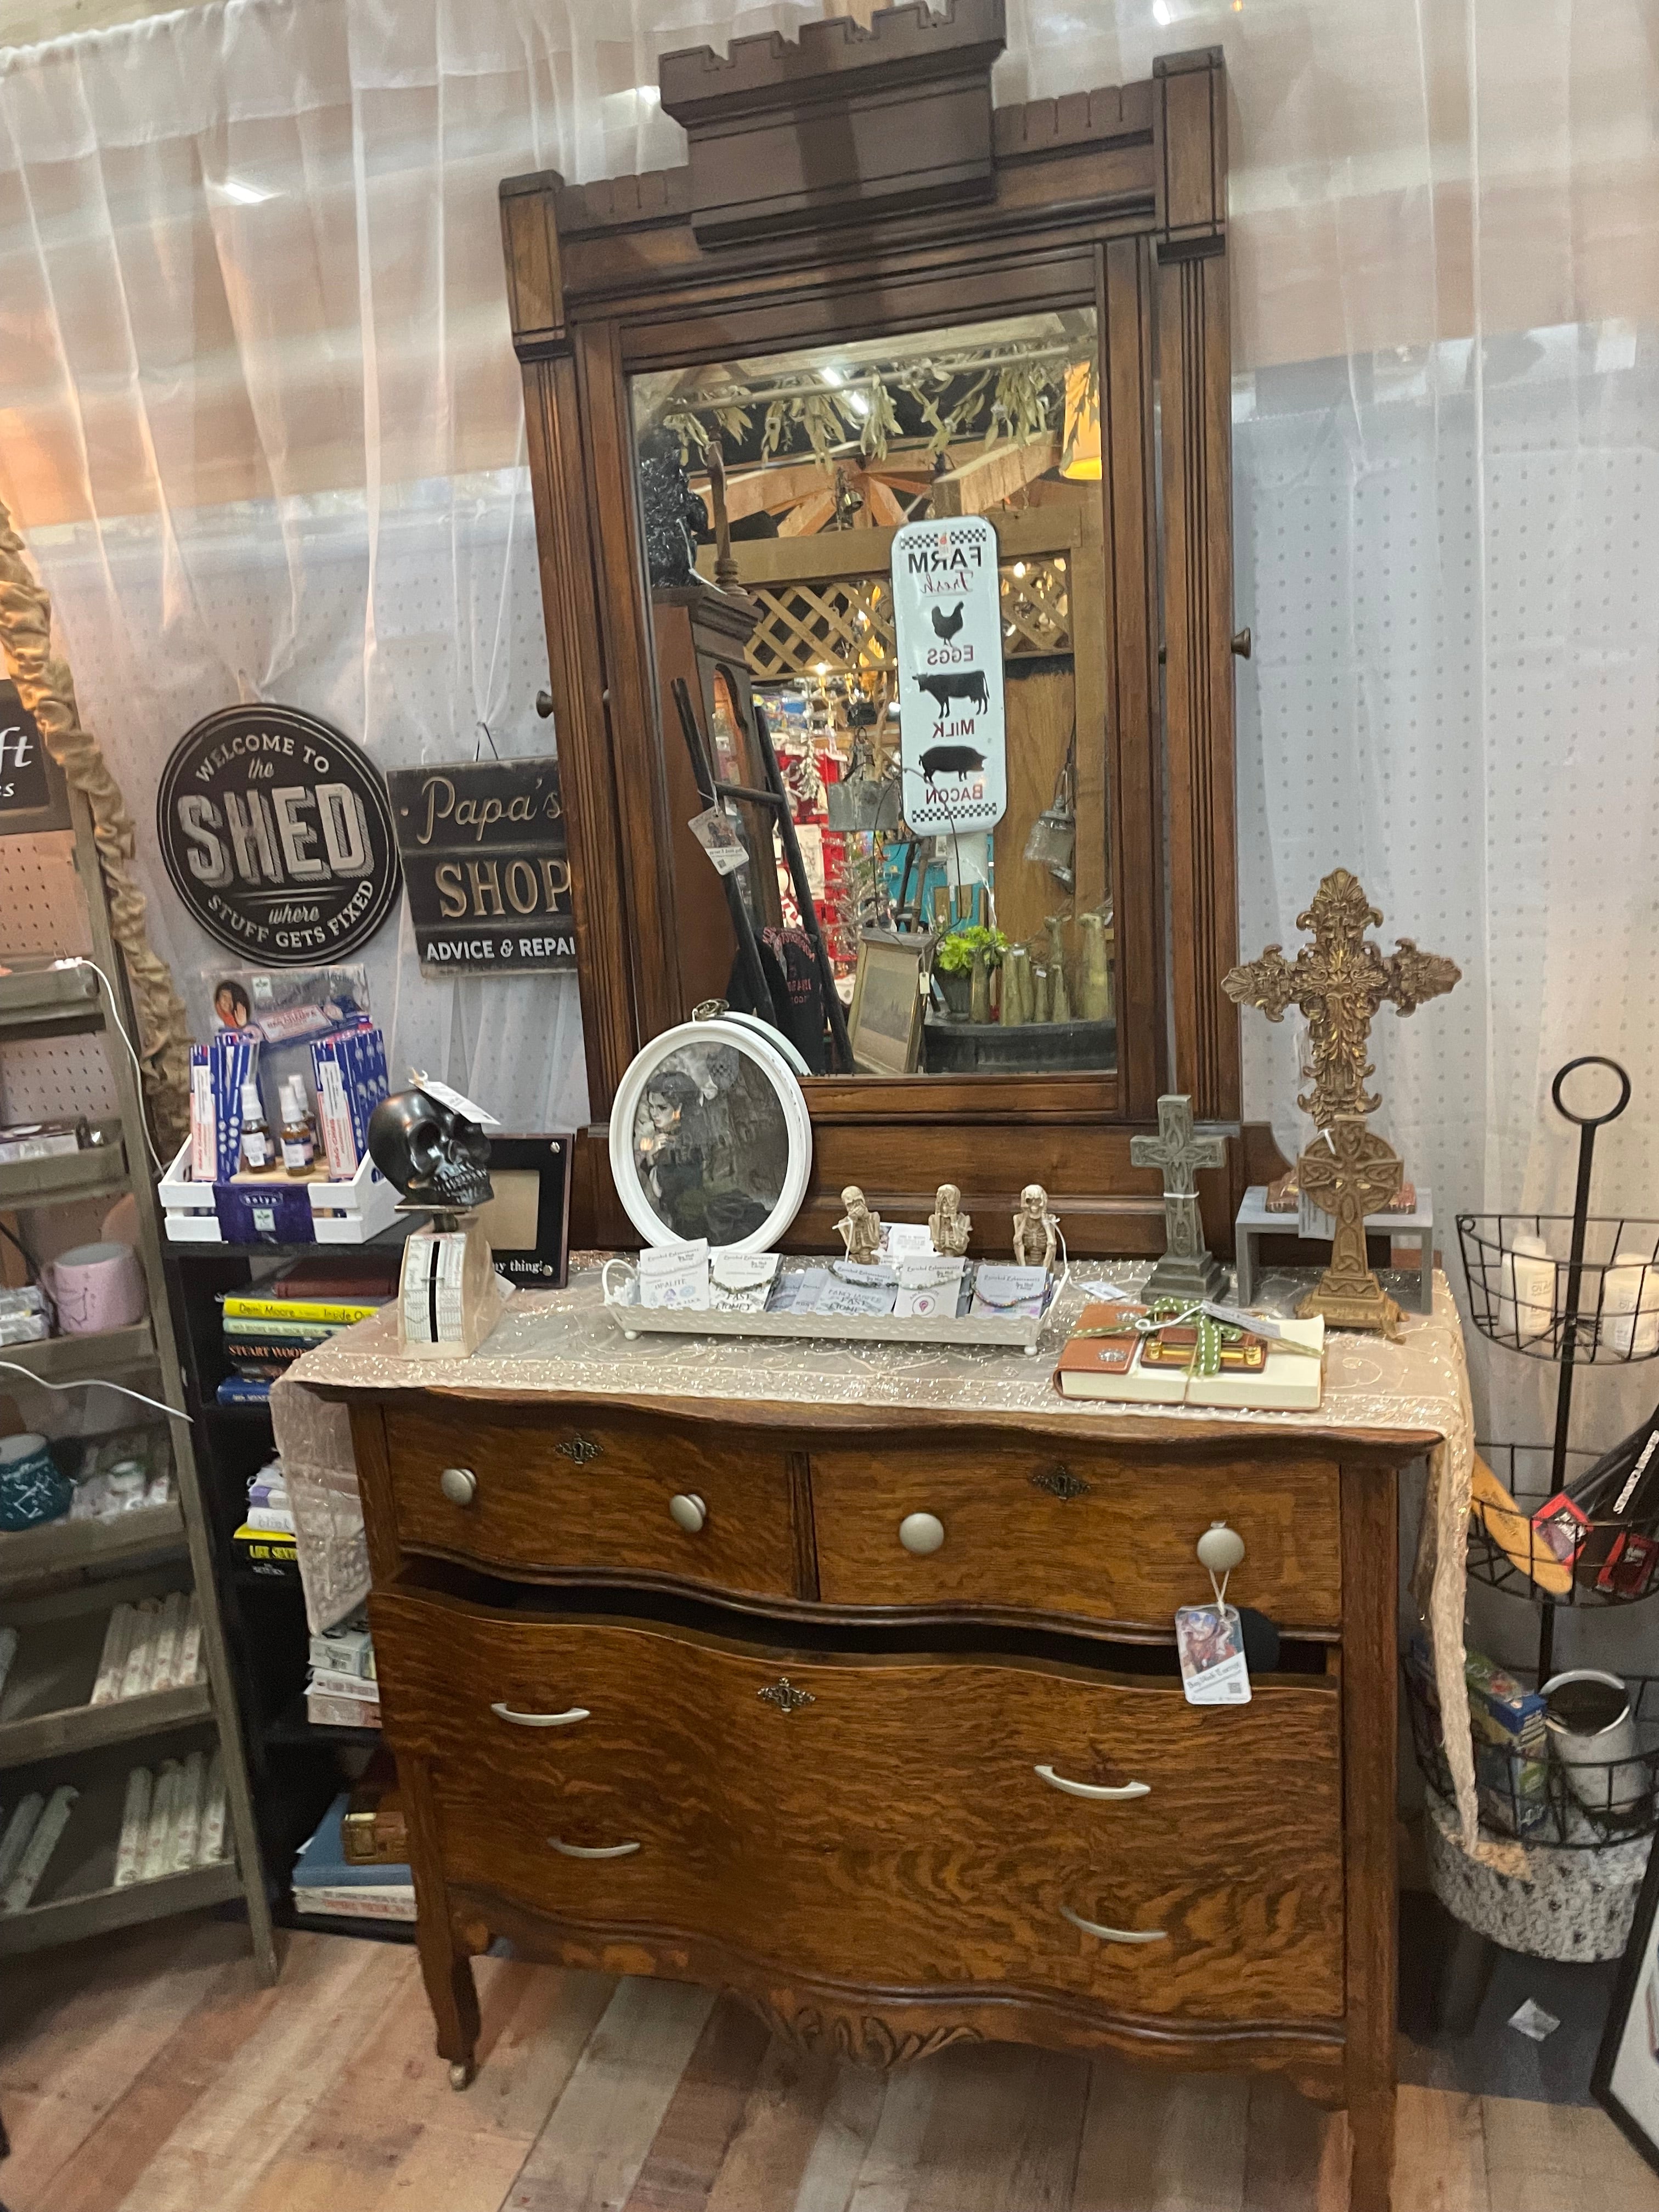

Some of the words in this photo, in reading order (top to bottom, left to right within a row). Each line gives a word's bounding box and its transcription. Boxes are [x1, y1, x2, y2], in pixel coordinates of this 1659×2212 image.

[195, 733, 295, 783] WELCOME
[303, 748, 330, 774] TO
[248, 757, 274, 780] the
[416, 776, 563, 844] Papa's
[177, 782, 376, 889] SHED
[435, 859, 570, 919] SHOP
[208, 894, 269, 942] STUFF
[275, 928, 326, 948] GETS
[326, 880, 375, 936] FIXED
[268, 903, 320, 925] where
[426, 940, 495, 961] ADVICE
[500, 940, 514, 958] &
[519, 937, 575, 957] REPAI
[510, 1259, 543, 1274] thing!
[265, 1305, 295, 1317] Moore
